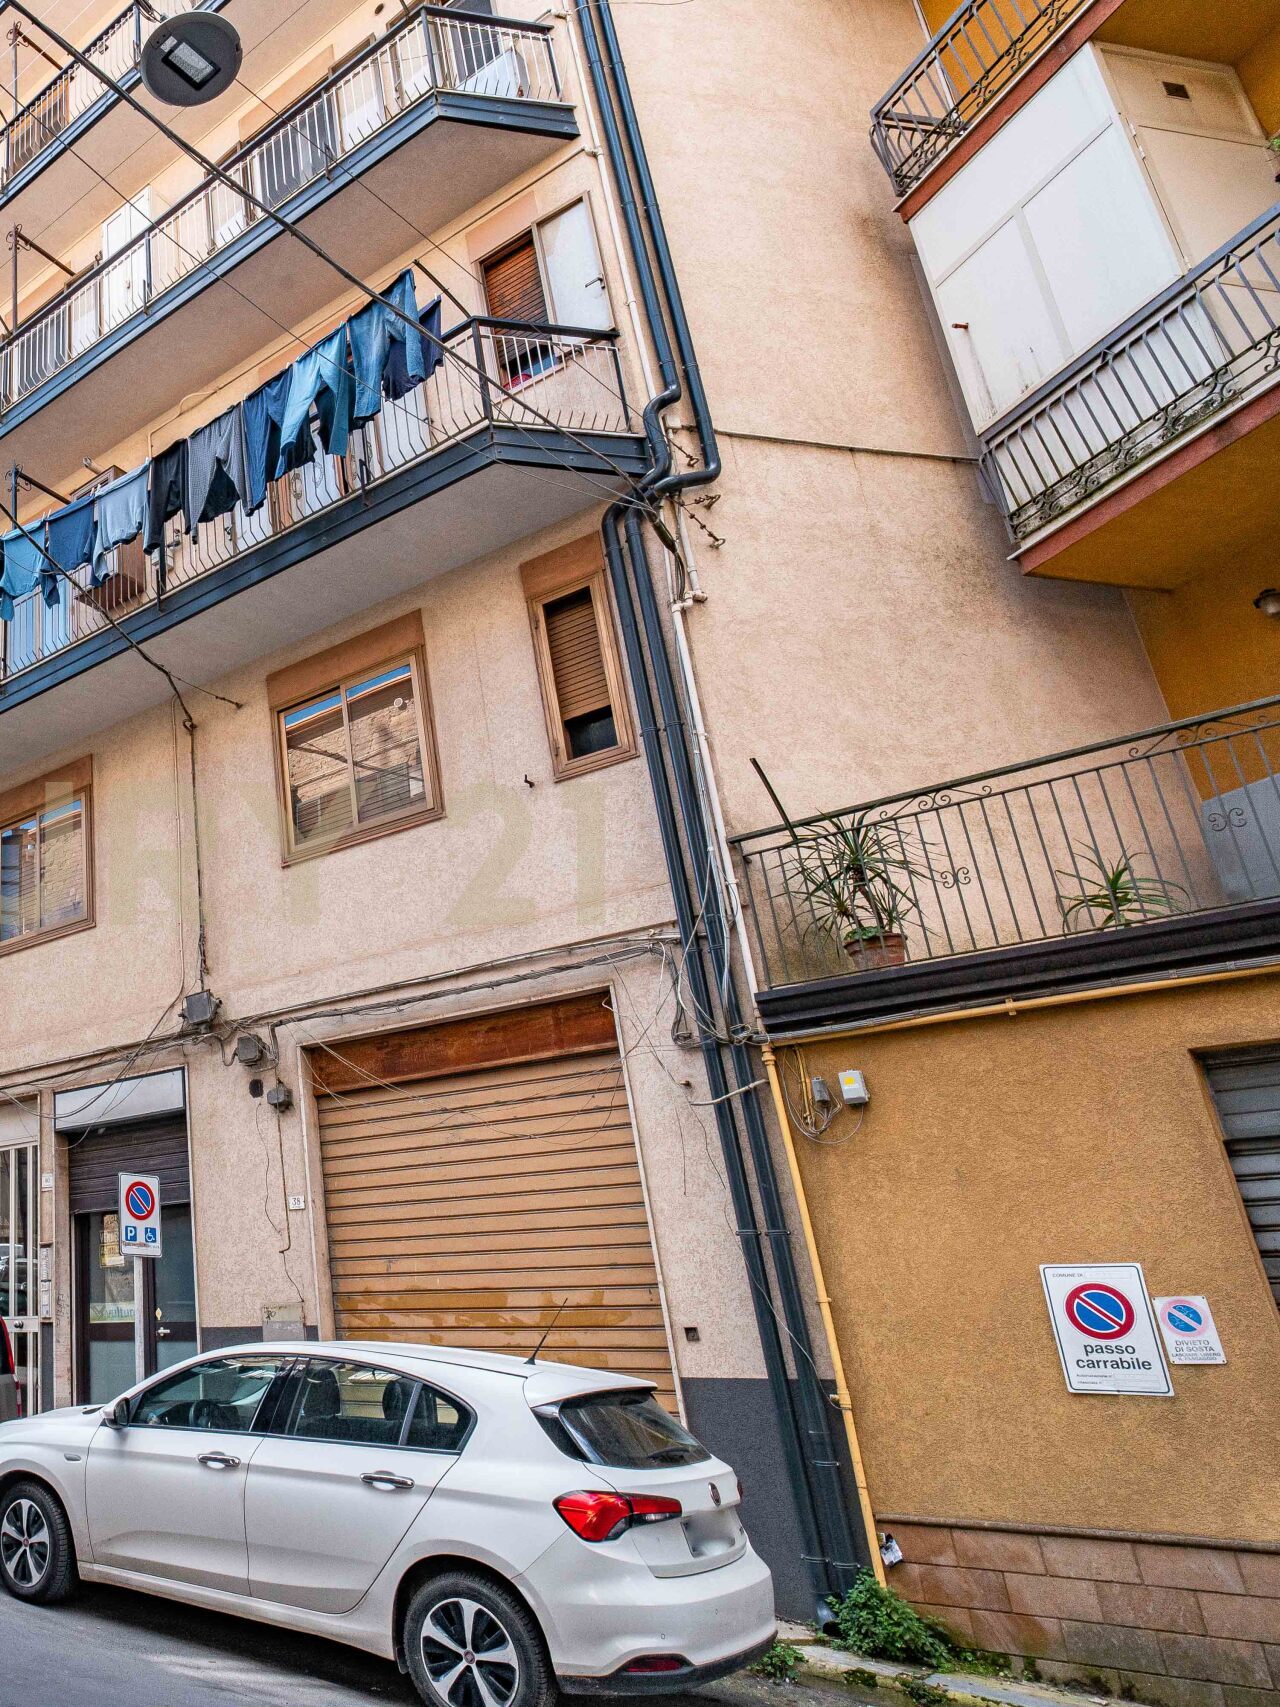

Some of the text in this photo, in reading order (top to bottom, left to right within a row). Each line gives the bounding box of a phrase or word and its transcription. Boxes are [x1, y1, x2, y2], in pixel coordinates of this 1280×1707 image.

[292, 1197, 301, 1206] 38
[127, 1227, 135, 1240] P
[1083, 1344, 1136, 1357] passo
[1075, 1357, 1152, 1370] carrabile
